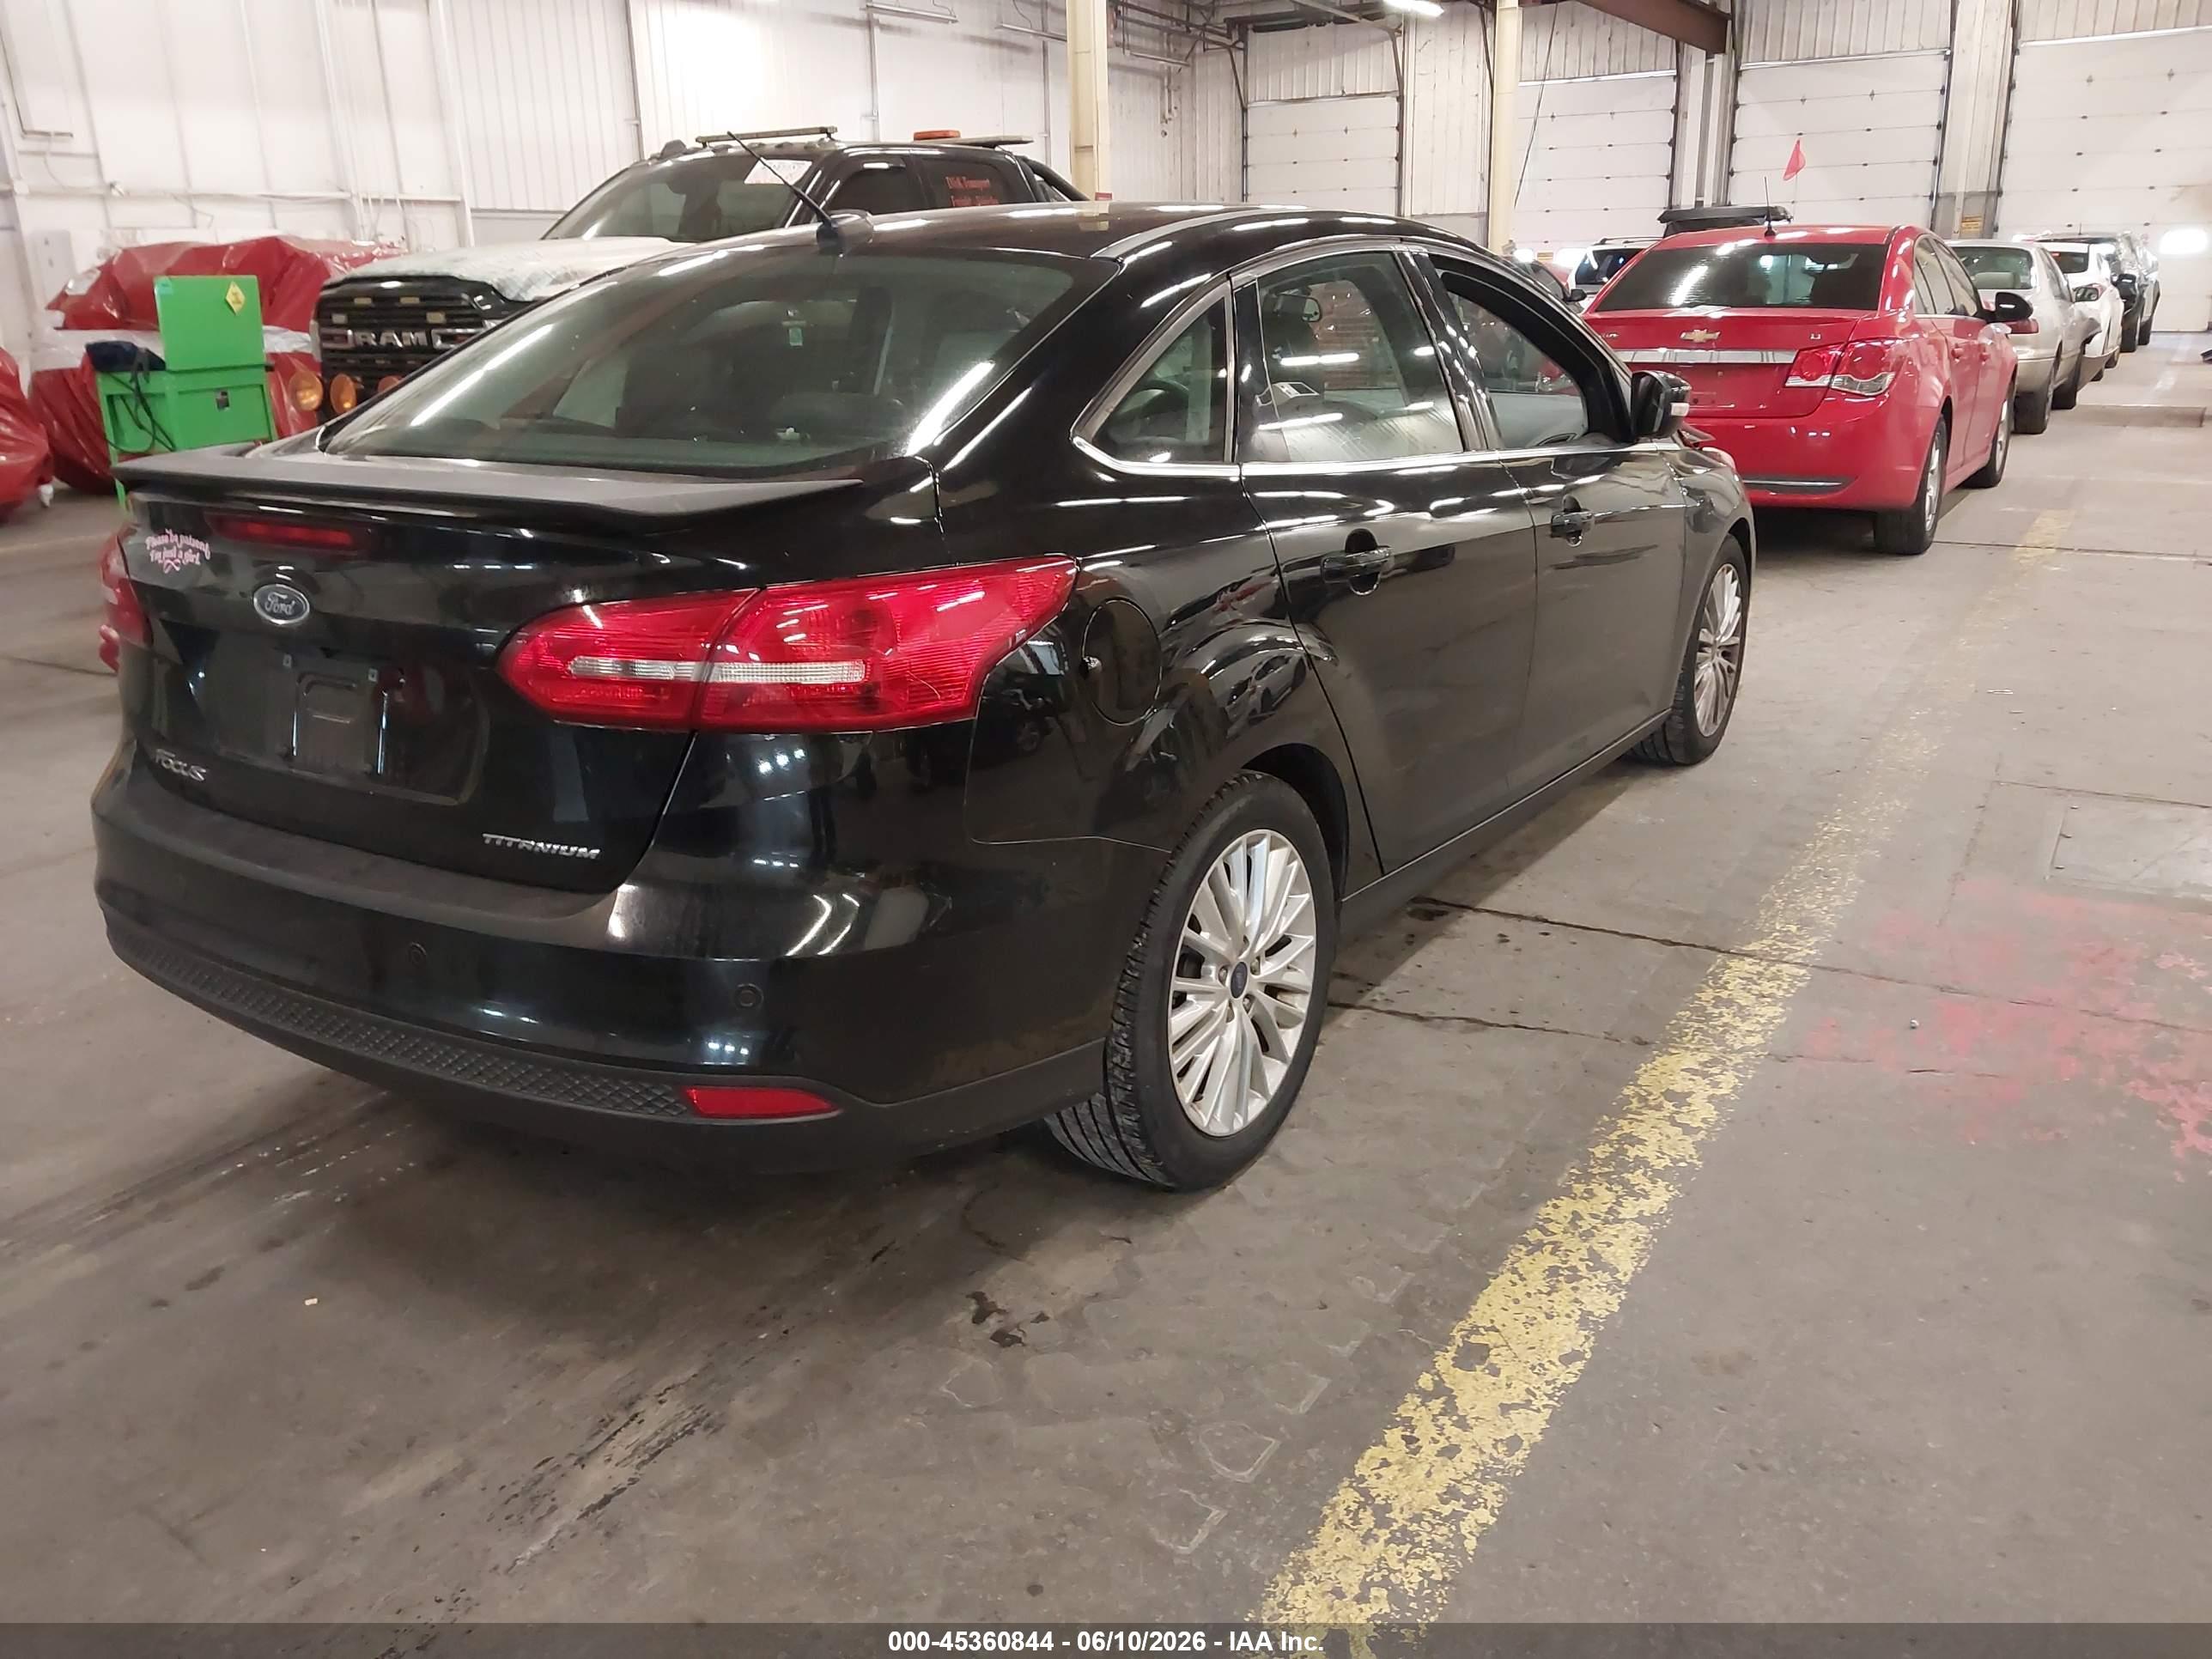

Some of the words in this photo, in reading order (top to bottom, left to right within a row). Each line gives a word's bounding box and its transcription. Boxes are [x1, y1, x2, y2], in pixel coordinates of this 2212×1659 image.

[354, 329, 428, 348] RAM
[264, 592, 296, 616] Ford
[155, 748, 207, 781] FOCUS
[482, 833, 600, 859] TITANIUM
